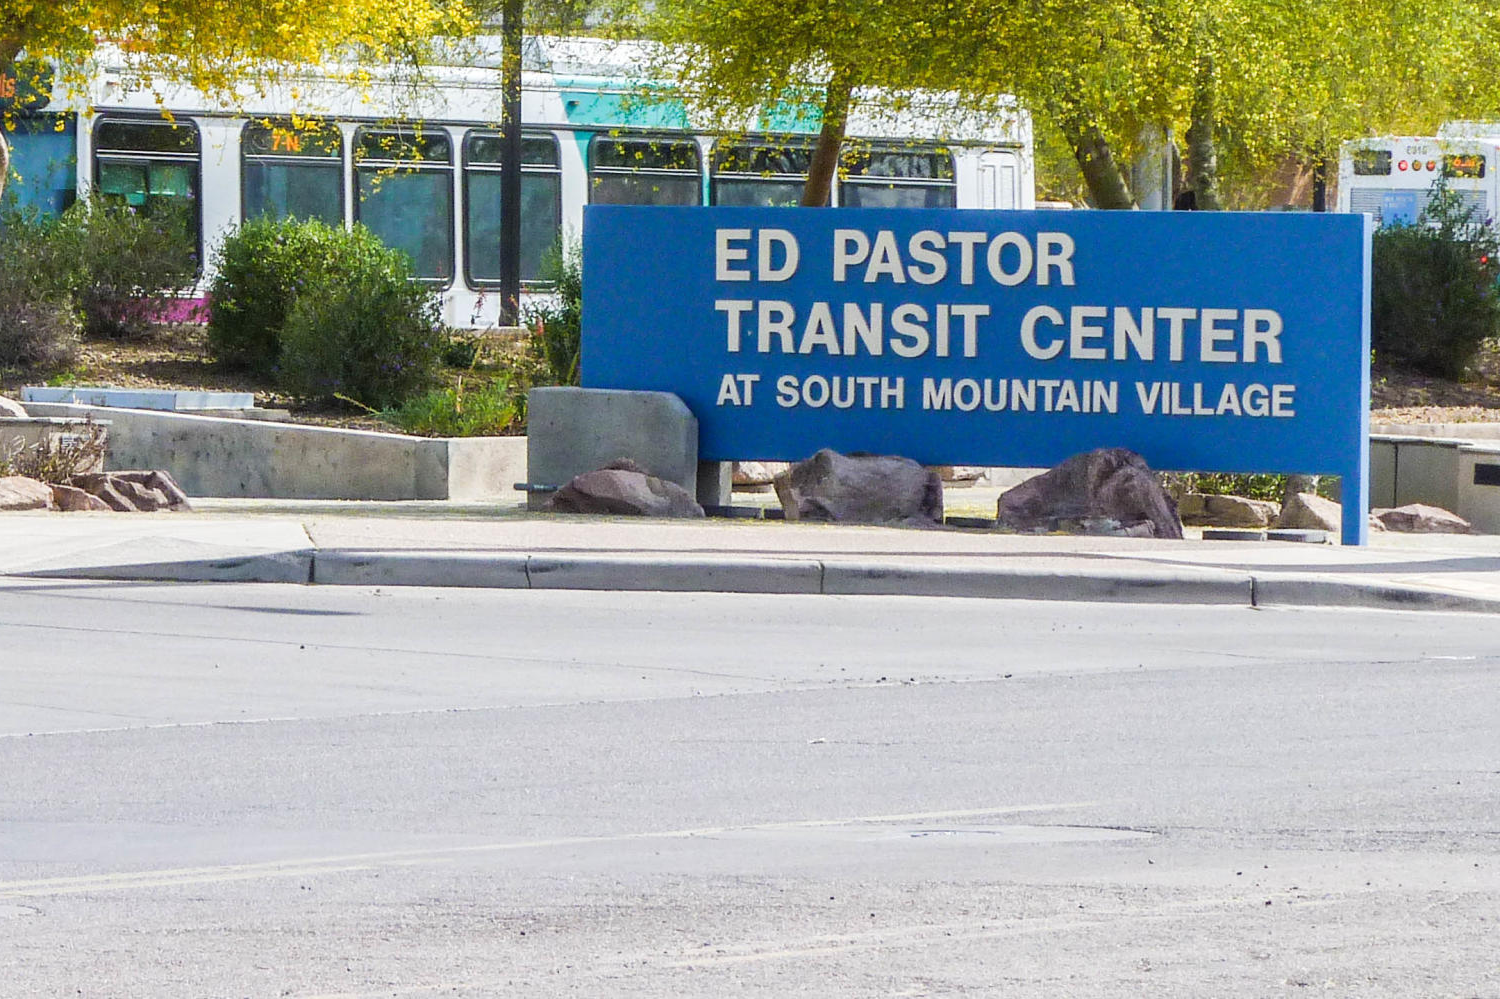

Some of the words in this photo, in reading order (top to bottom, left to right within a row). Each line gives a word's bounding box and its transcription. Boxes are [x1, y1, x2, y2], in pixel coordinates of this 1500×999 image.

[714, 228, 799, 282] ED
[833, 229, 1076, 286] PASTOR
[714, 299, 990, 358] TRANSIT
[1020, 305, 1284, 364] CENTER
[716, 374, 759, 406] AT
[775, 374, 904, 409] SOUTH
[922, 377, 1118, 413] MOUNTAIN
[1135, 381, 1296, 417] VILLAGE
